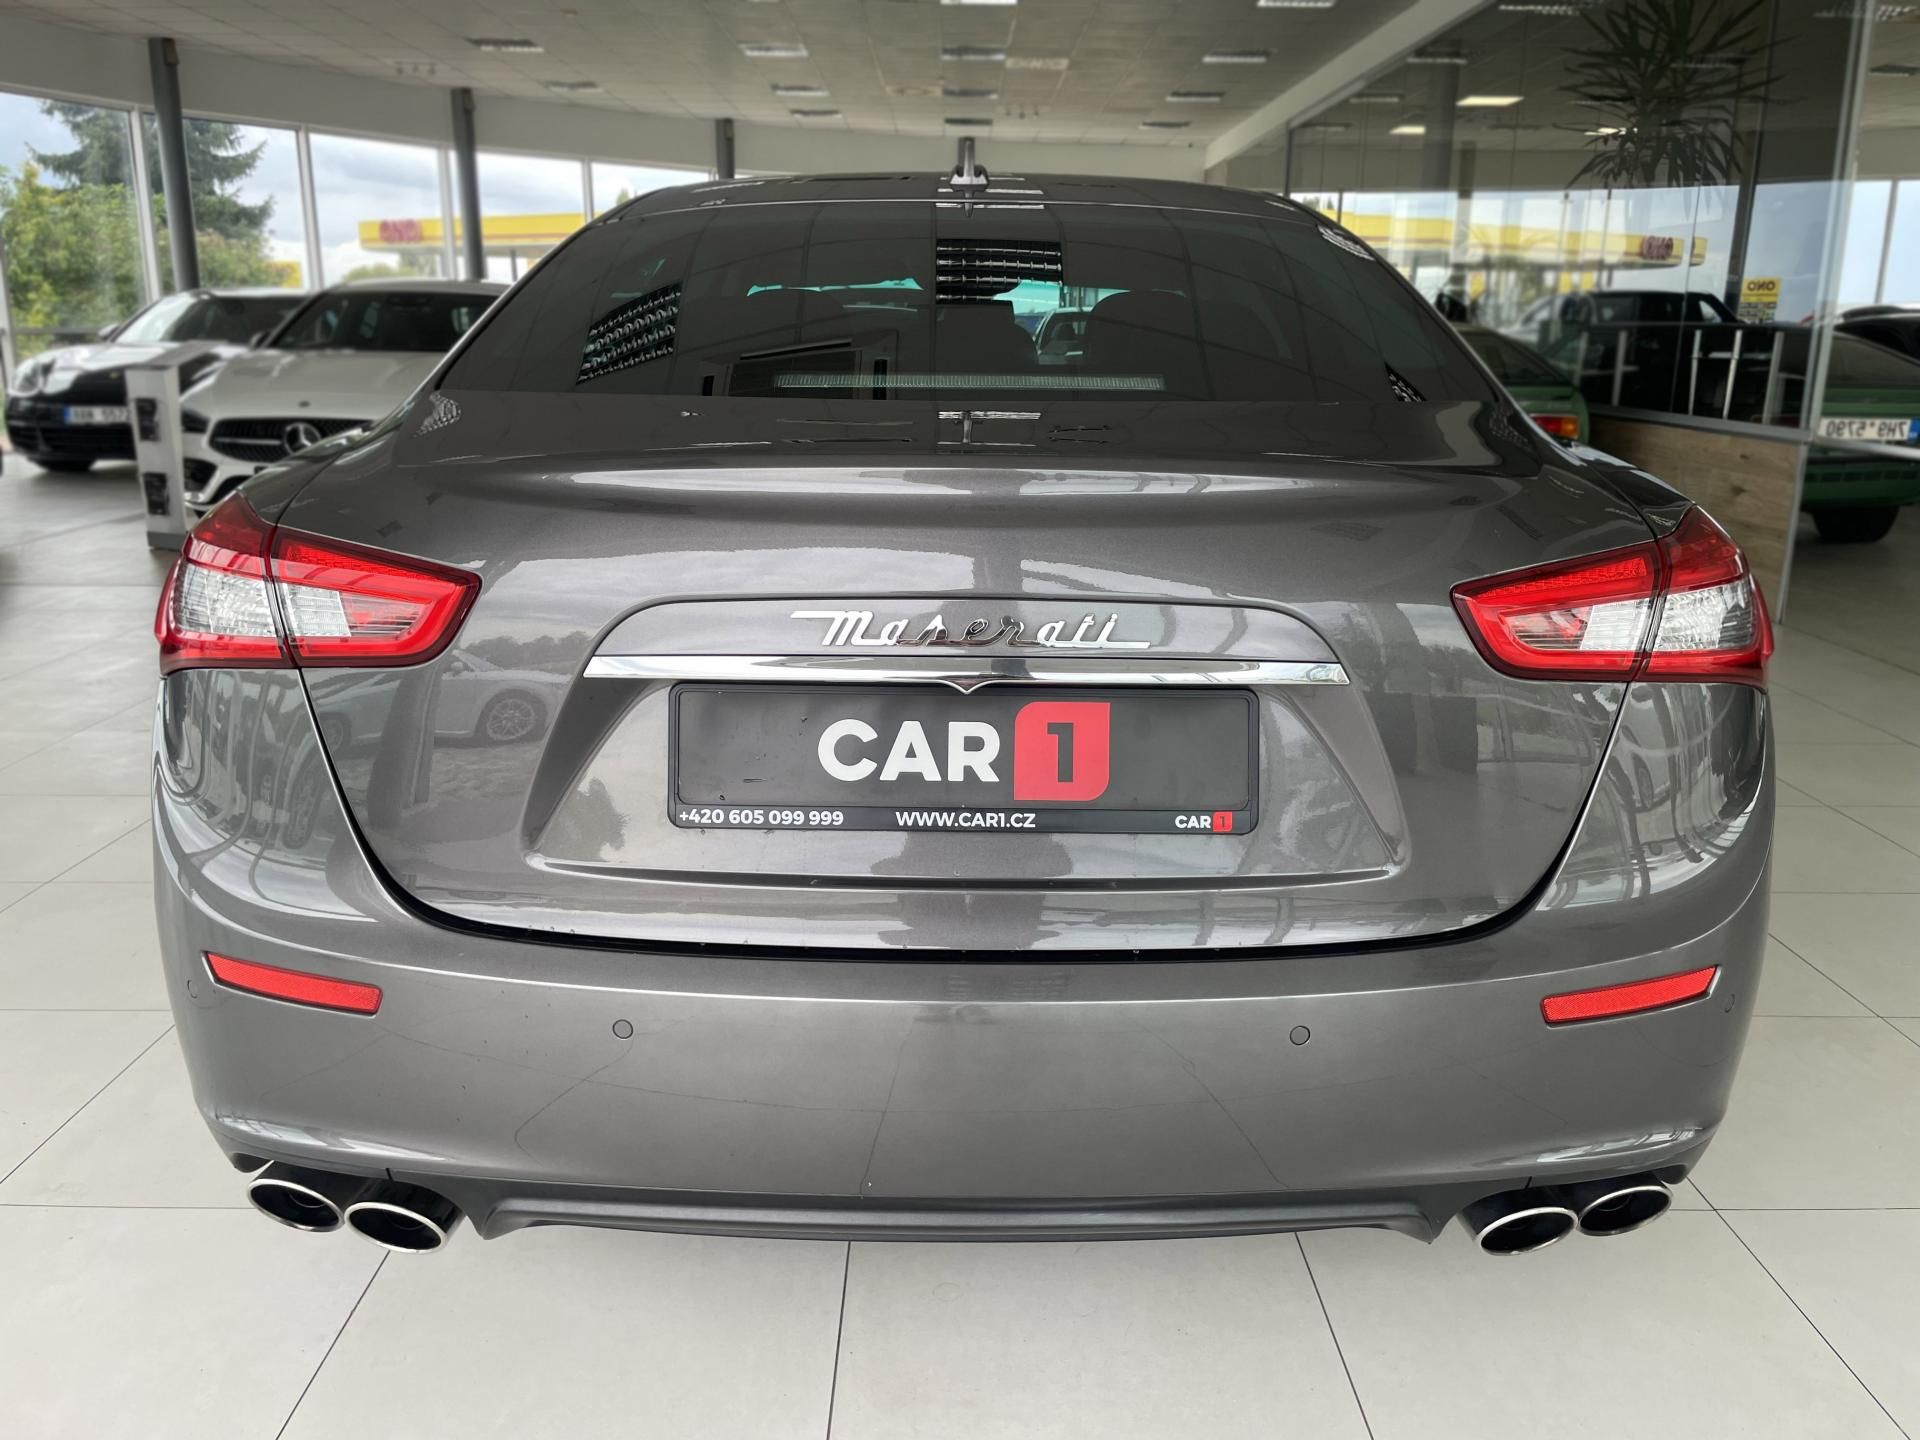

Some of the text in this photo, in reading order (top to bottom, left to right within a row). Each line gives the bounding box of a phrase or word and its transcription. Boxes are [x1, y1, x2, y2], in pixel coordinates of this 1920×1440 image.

[791, 610, 1150, 648] Maserati
[679, 808, 844, 826] +420 605 099 999
[895, 811, 1036, 828] WWW.CAR1.CZ
